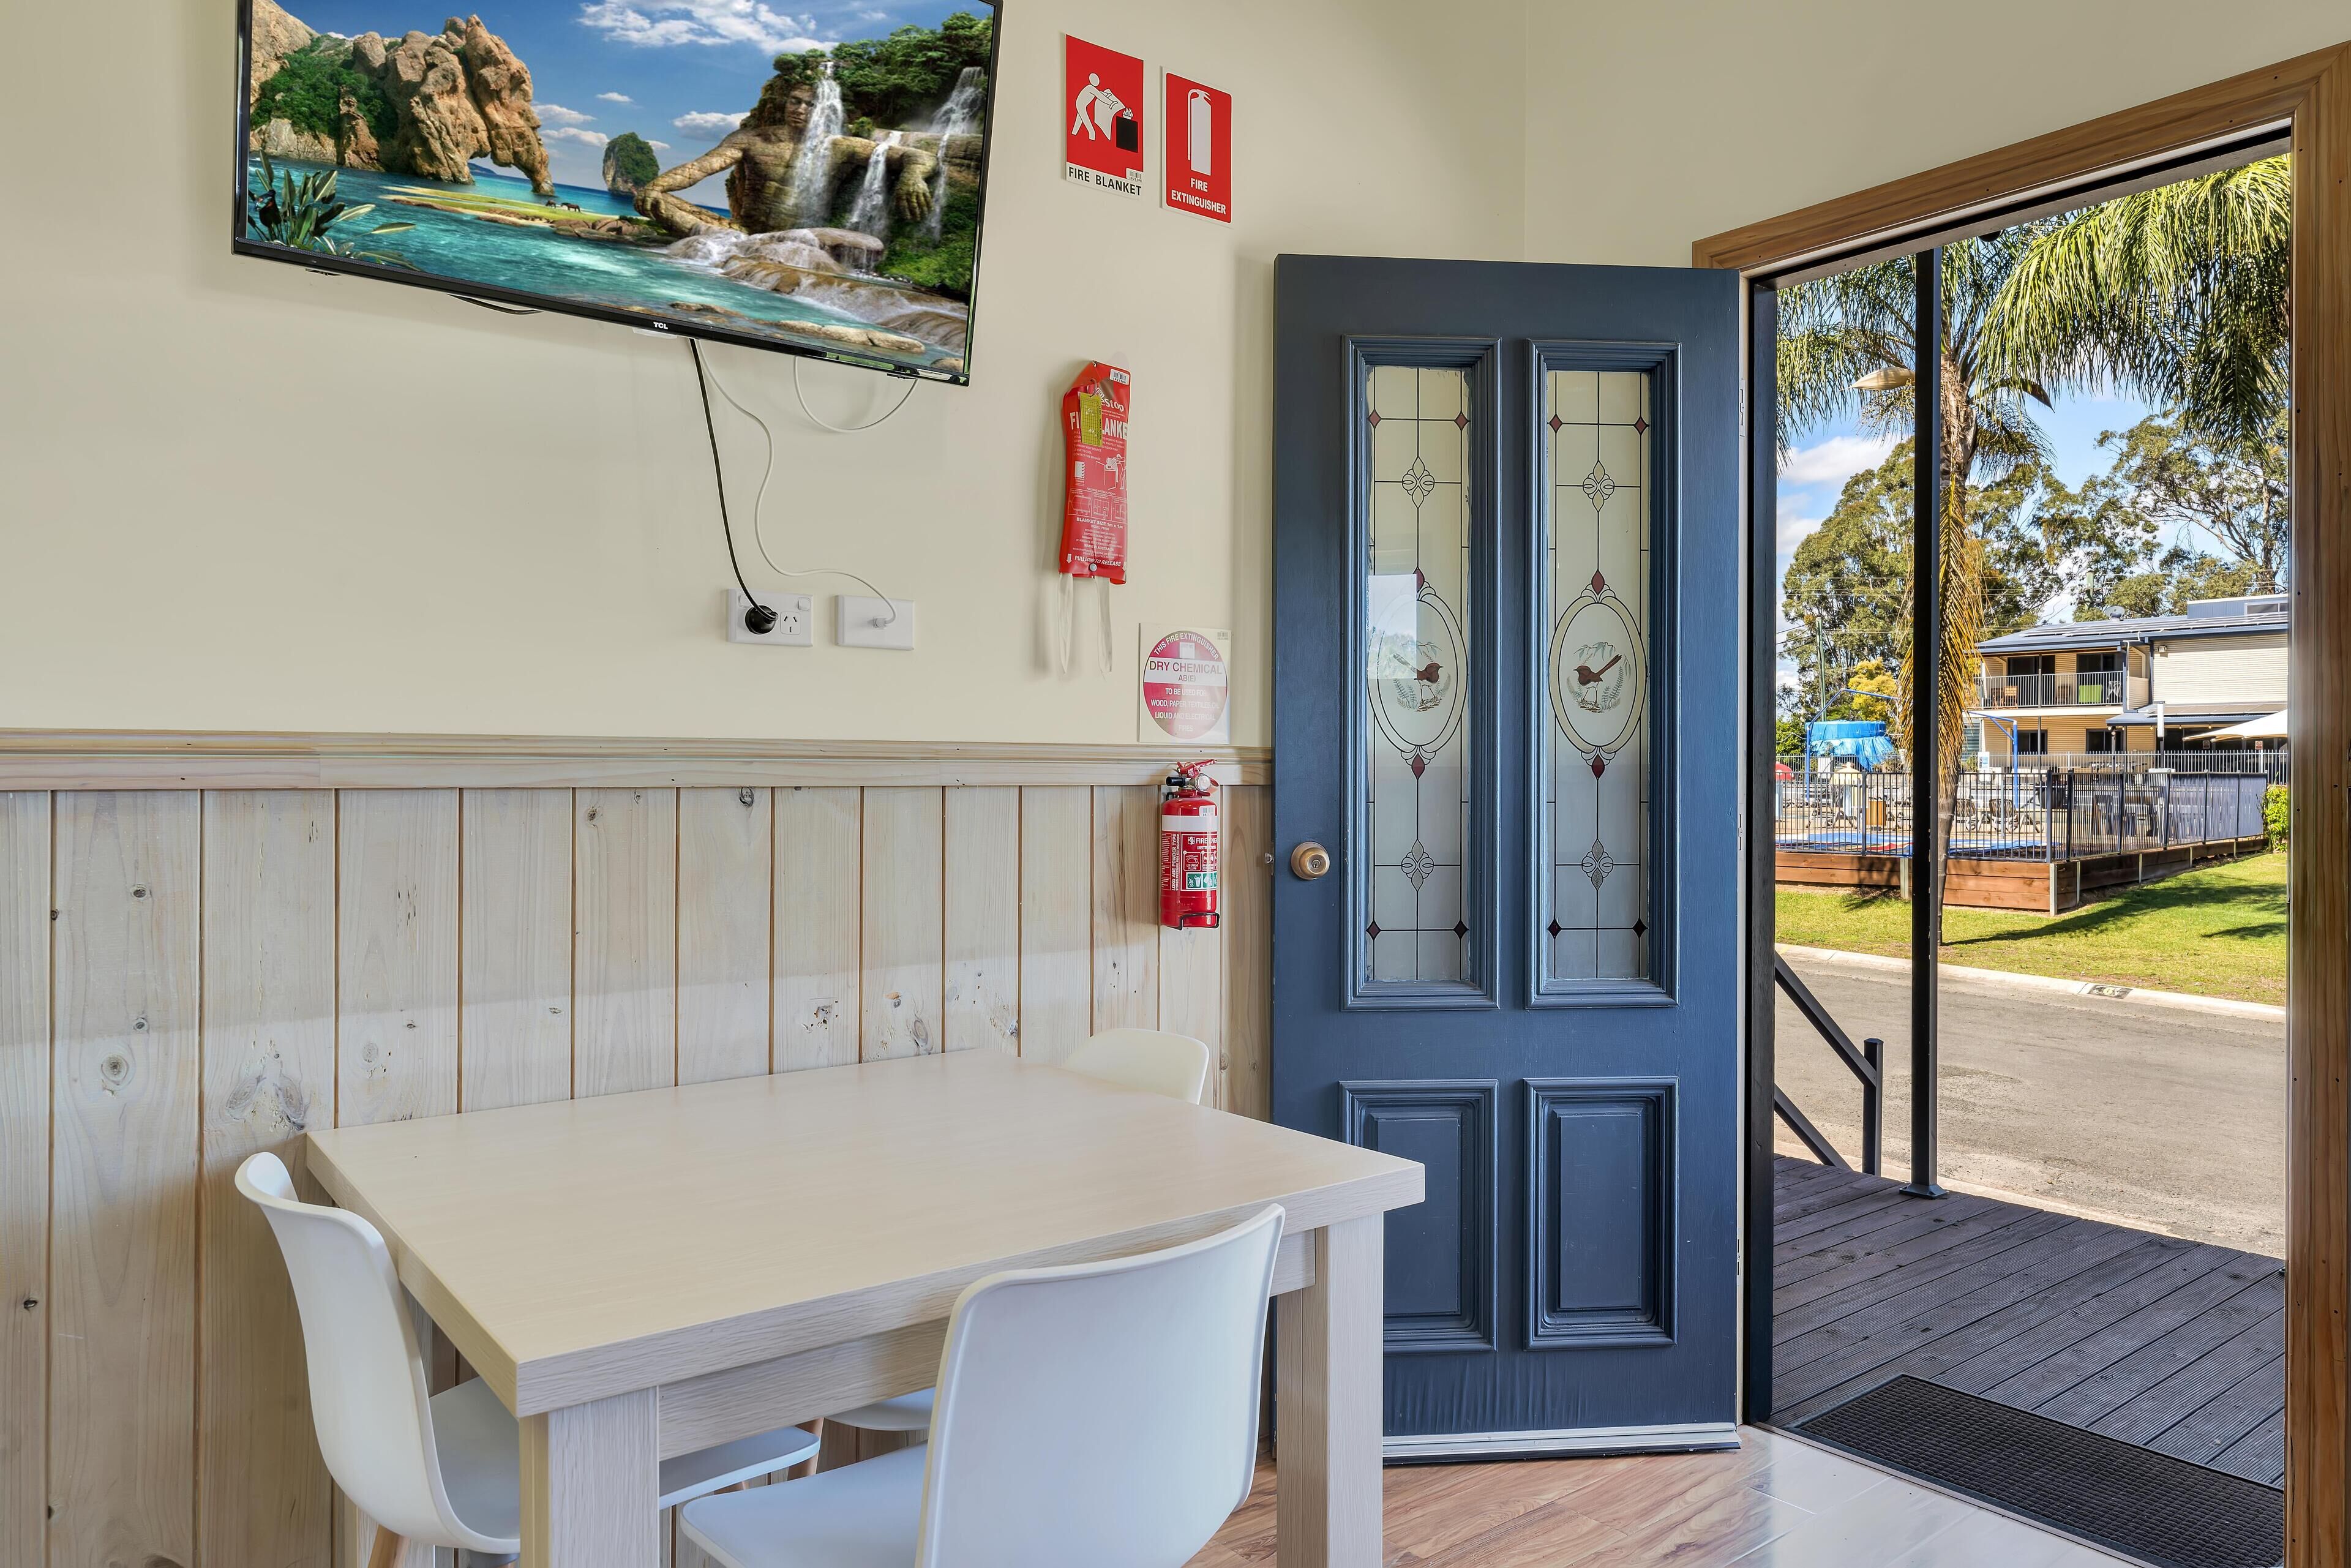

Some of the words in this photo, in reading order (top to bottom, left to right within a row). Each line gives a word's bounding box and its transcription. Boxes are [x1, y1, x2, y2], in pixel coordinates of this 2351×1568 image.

[1069, 167, 1090, 182] FIRE
[1096, 174, 1142, 196] BLANKET
[1191, 178, 1208, 192] FIRE
[1171, 189, 1226, 215] EXTINGUISHER
[1101, 398, 1125, 412] eStop
[1070, 411, 1080, 430] FI
[1102, 418, 1128, 440] ANKE
[1153, 642, 1166, 655] THIS
[1166, 634, 1179, 645] FIRE
[1180, 632, 1219, 660] EXTINGUISHER
[1149, 661, 1170, 671] DRY
[1172, 662, 1223, 675] CHEMICAL
[1151, 699, 1169, 708] WOOD,
